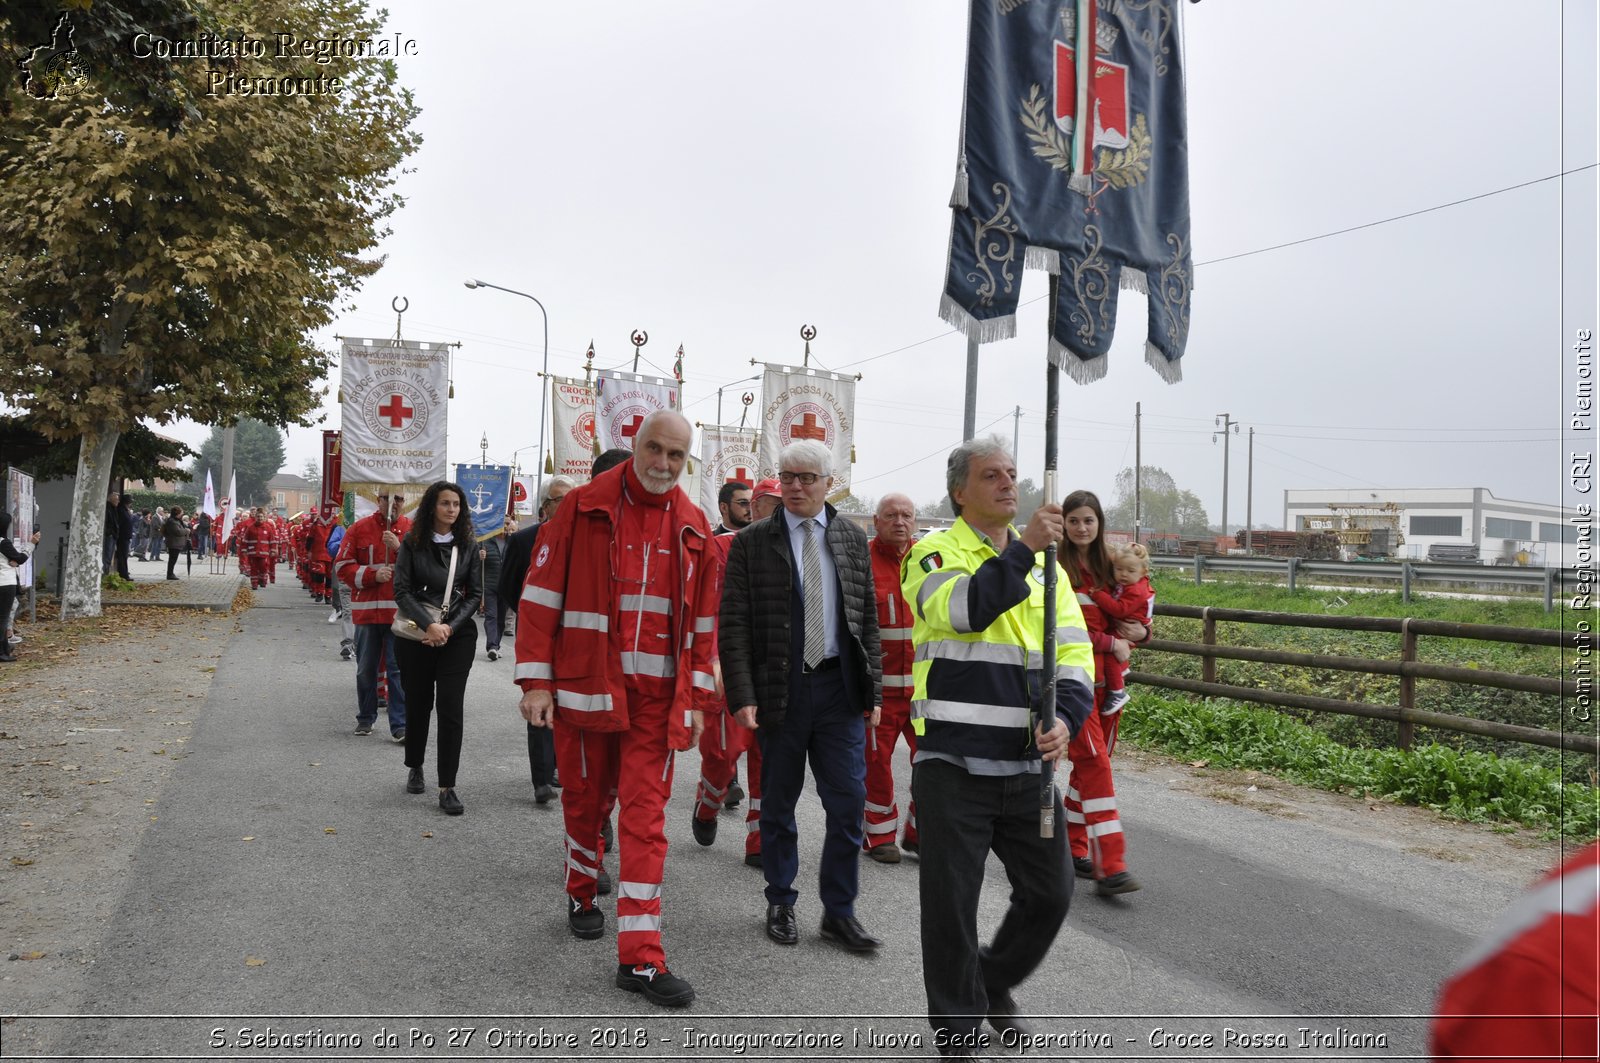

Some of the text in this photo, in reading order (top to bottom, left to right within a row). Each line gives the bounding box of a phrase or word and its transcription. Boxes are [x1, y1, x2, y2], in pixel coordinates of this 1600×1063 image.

[401, 360, 430, 369] PIONIERI
[349, 367, 441, 406] CROCE ROSSA ITALIANA
[570, 396, 595, 405] ITALI
[601, 395, 622, 418] CROCE
[646, 394, 664, 410] ITALI
[766, 385, 849, 433] CROCE ROSSA ITALIANA
[781, 412, 796, 446] NVENZIONE
[356, 447, 433, 457] COMITATO LOCALE
[723, 444, 749, 454] ROSSA
[357, 459, 433, 470] MONTANARO
[731, 458, 755, 468] GINEVRA
